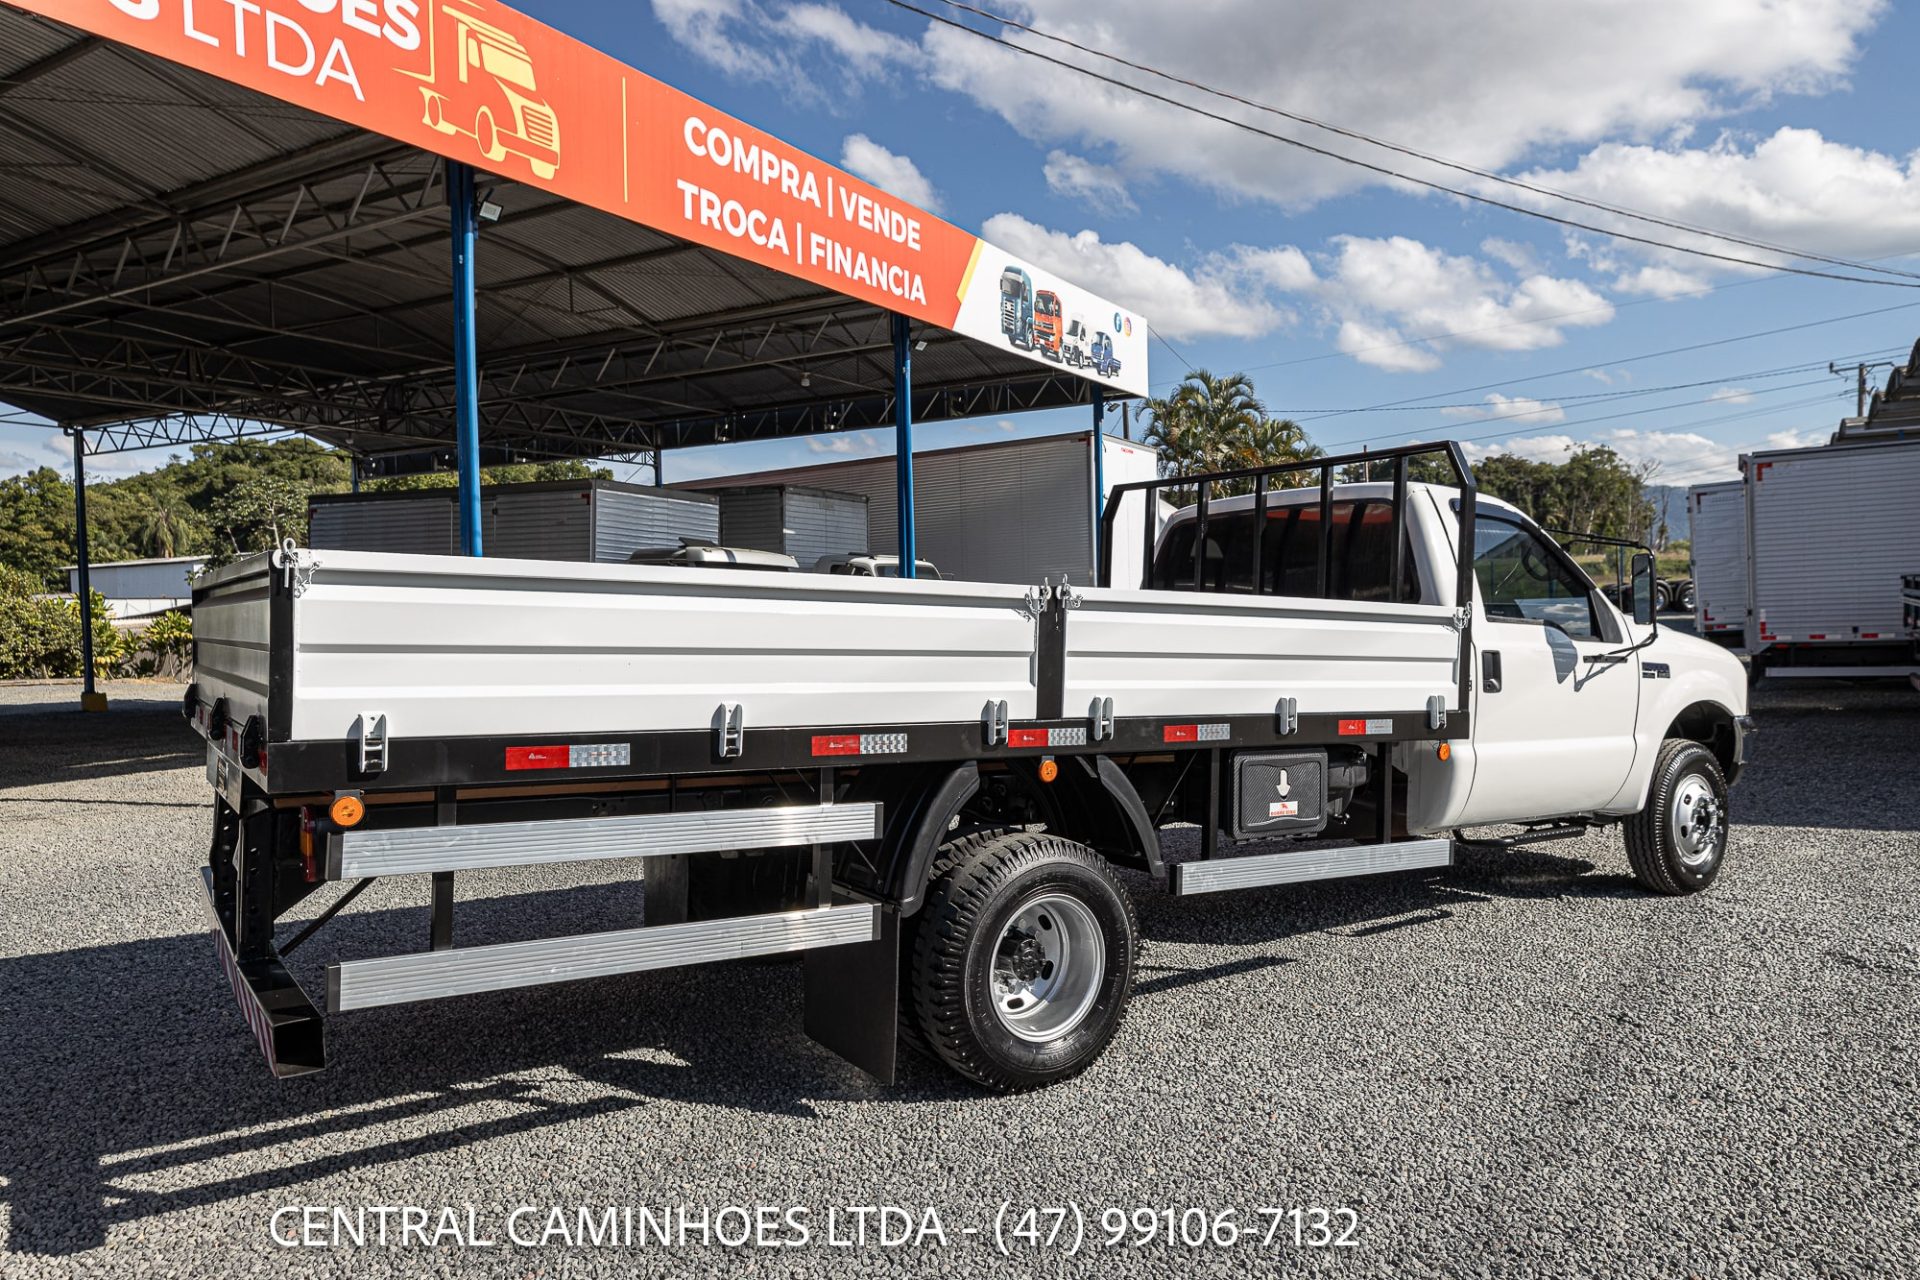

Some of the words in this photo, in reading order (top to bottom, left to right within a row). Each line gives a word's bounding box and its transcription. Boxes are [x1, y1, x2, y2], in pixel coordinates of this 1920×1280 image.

[183, 0, 365, 102] LTDA
[677, 179, 789, 256] TROCA
[810, 232, 926, 305] FINANCIA
[684, 117, 821, 208] COMPRA
[839, 186, 921, 251] VENDE
